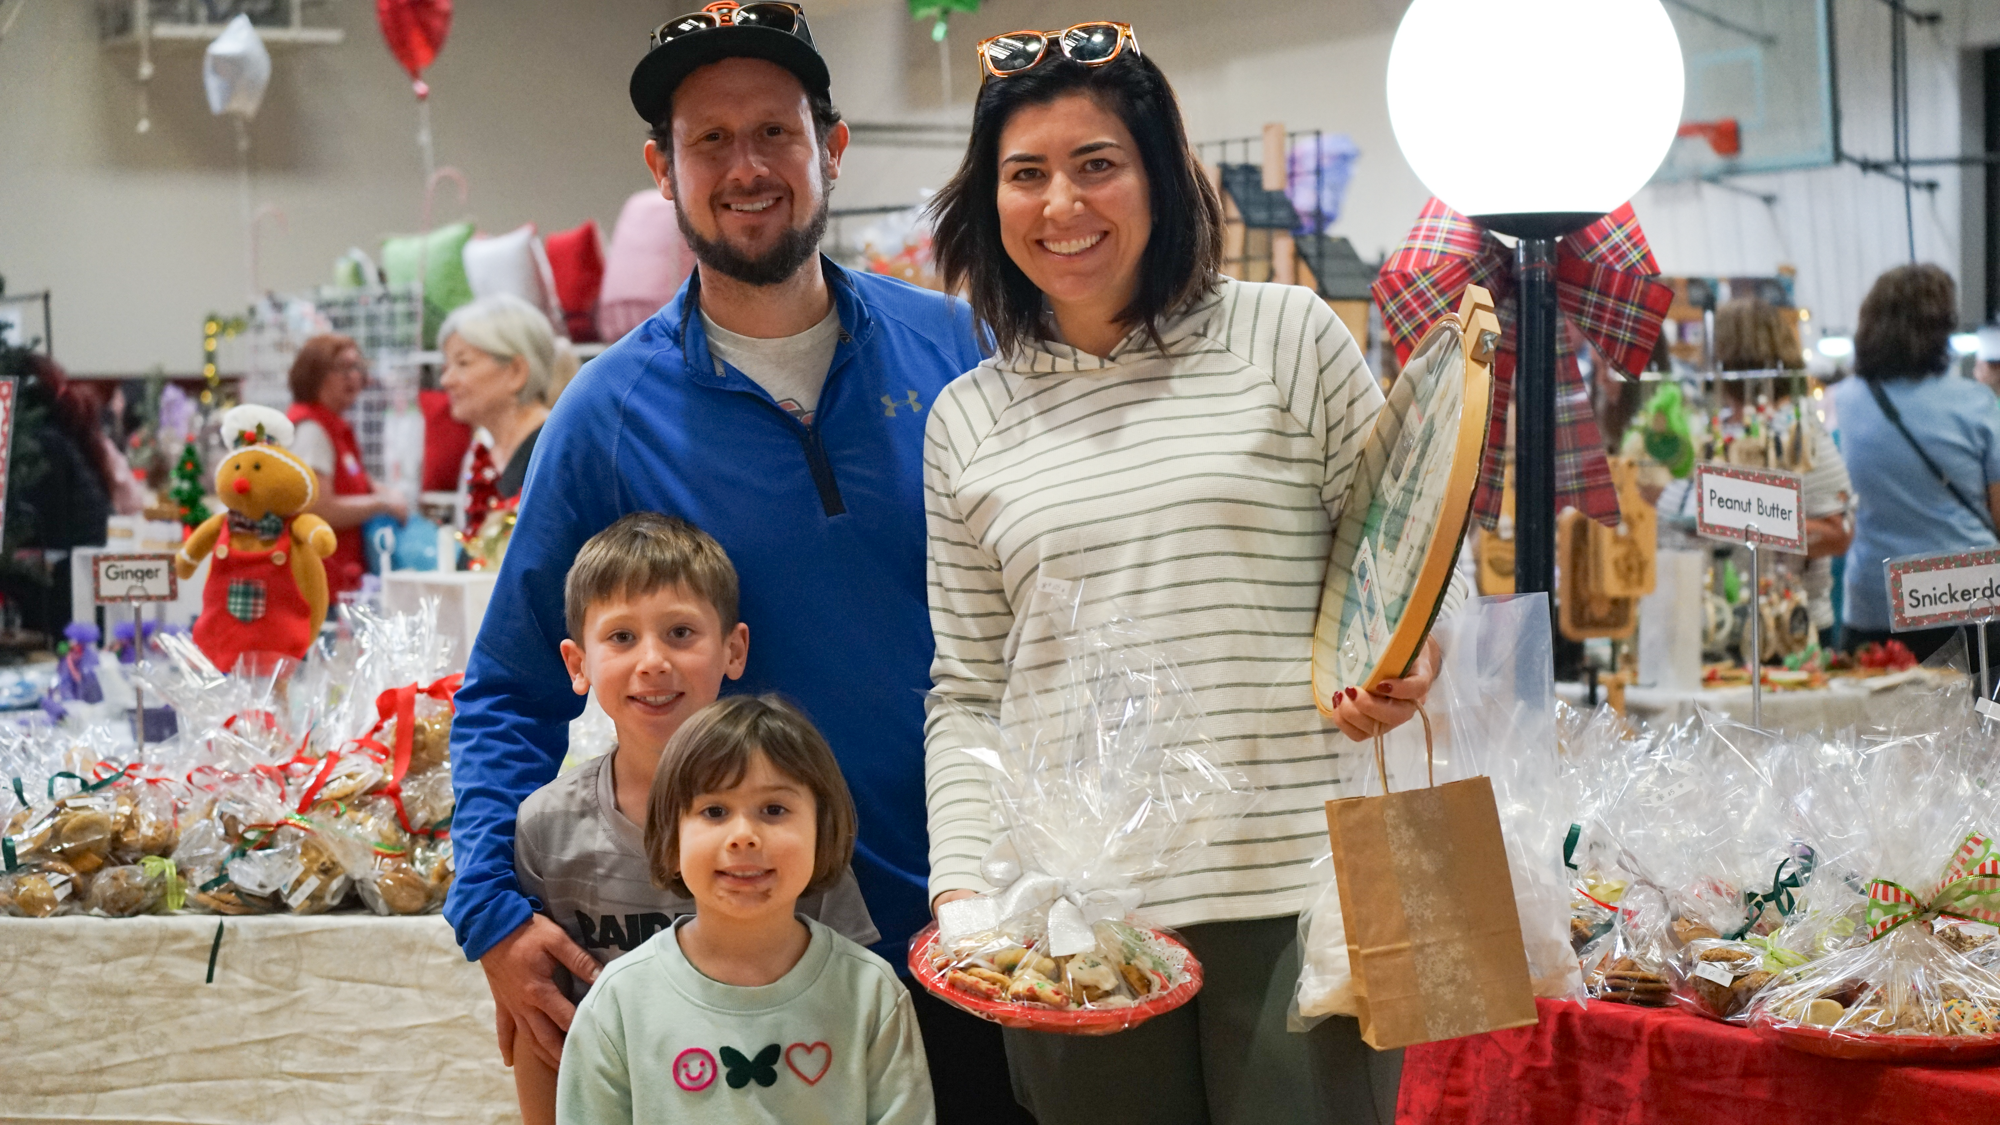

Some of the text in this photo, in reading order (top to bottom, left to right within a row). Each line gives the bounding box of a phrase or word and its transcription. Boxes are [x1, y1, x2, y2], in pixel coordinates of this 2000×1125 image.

[1709, 488, 1793, 521] Peanut Butter
[105, 563, 161, 583] Ginger
[575, 909, 697, 952] RAID
